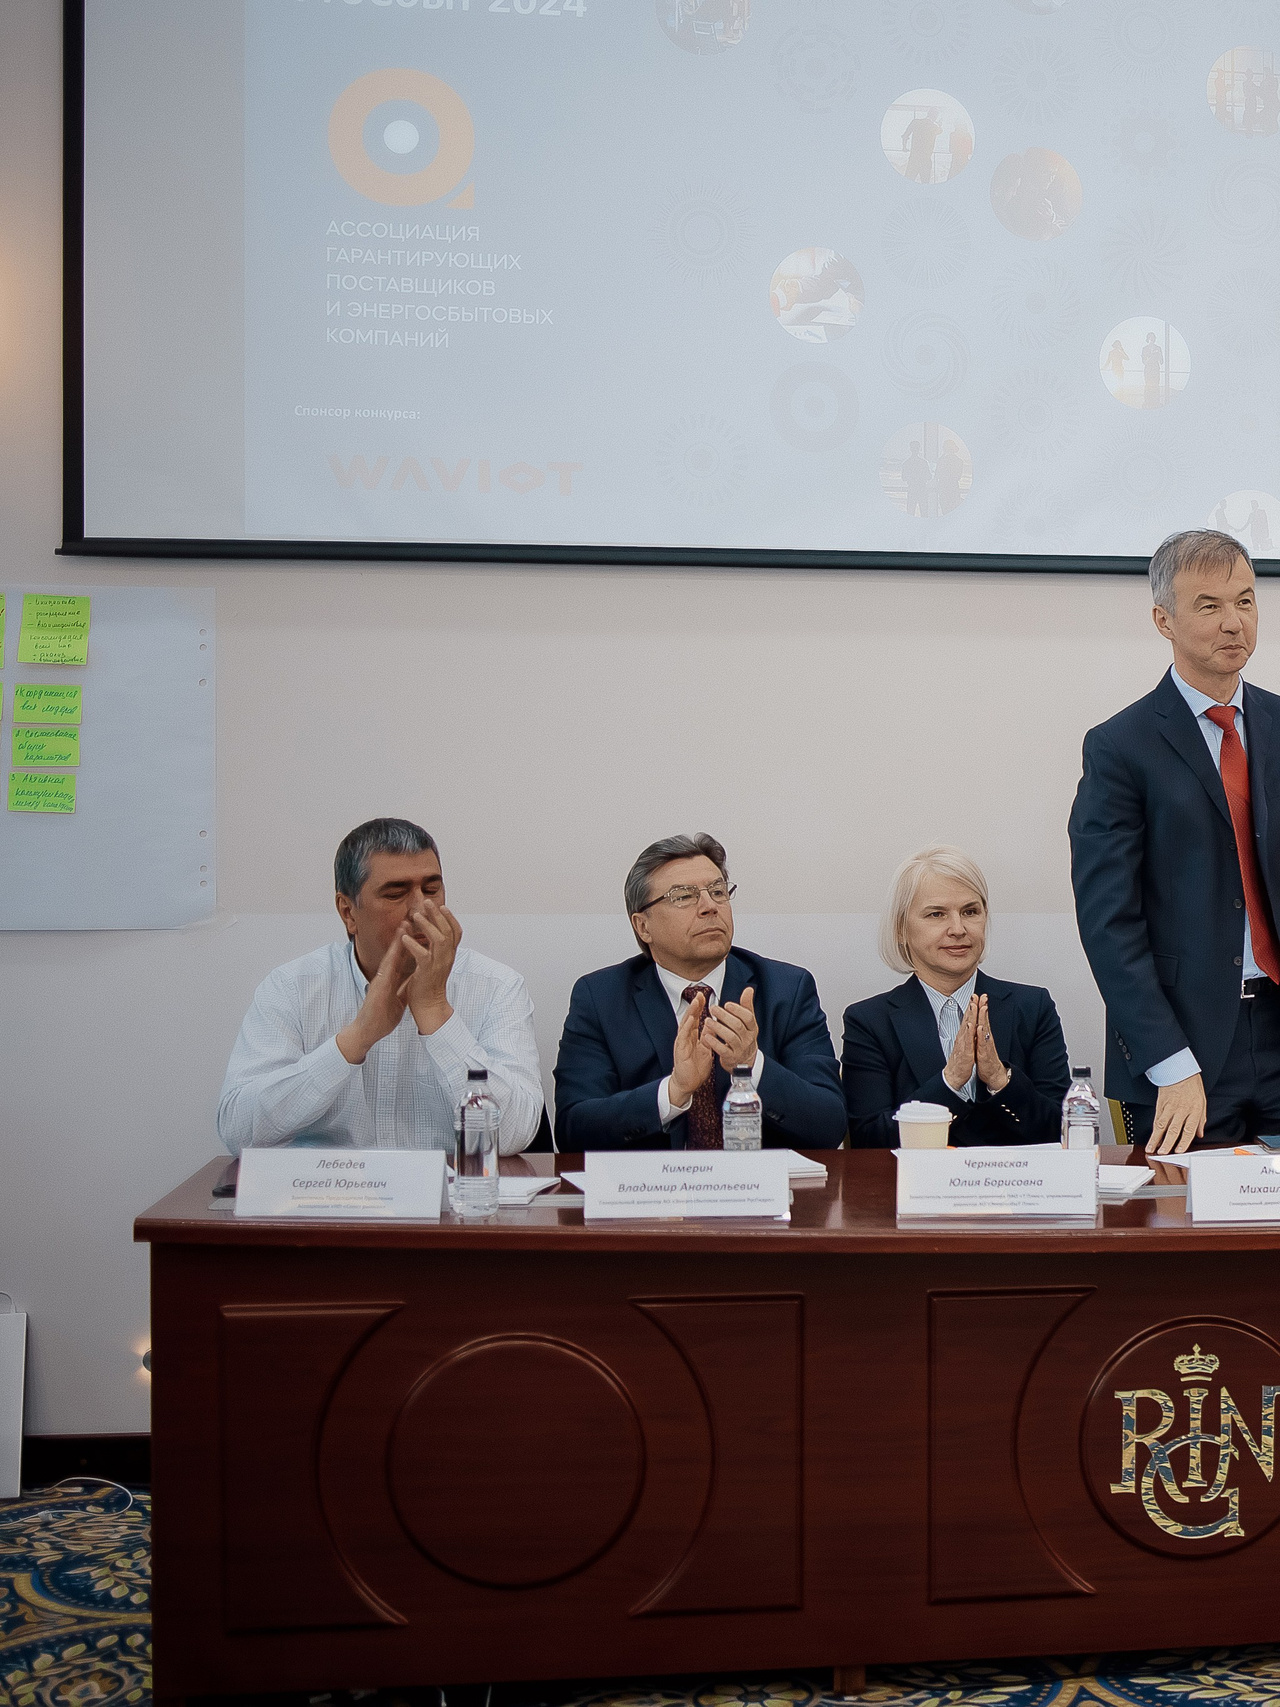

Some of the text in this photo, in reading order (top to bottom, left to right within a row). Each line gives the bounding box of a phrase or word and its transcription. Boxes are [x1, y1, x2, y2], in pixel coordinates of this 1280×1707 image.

[326, 220, 480, 243] АССОЦИАЦИЯ
[326, 246, 523, 272] ГАРАНТИРУЮЩИХ
[326, 273, 496, 297] ПОСТАВЩИКОВ
[326, 301, 554, 325] И ЭНЕРГОСБЫТОВЫХ
[326, 326, 450, 348] КОМПАНИЙ
[294, 404, 422, 421] Спонсор конкурса:
[327, 453, 584, 496] WAVIOT
[316, 1158, 366, 1170] Лебедев
[661, 1163, 714, 1176] Кимерин
[964, 1158, 1029, 1171] Чернявская
[292, 1177, 387, 1191] Сергей Юрьевич
[618, 1180, 760, 1194] Владимир Анатольевич
[949, 1177, 1043, 1188] Юлия Борисовна
